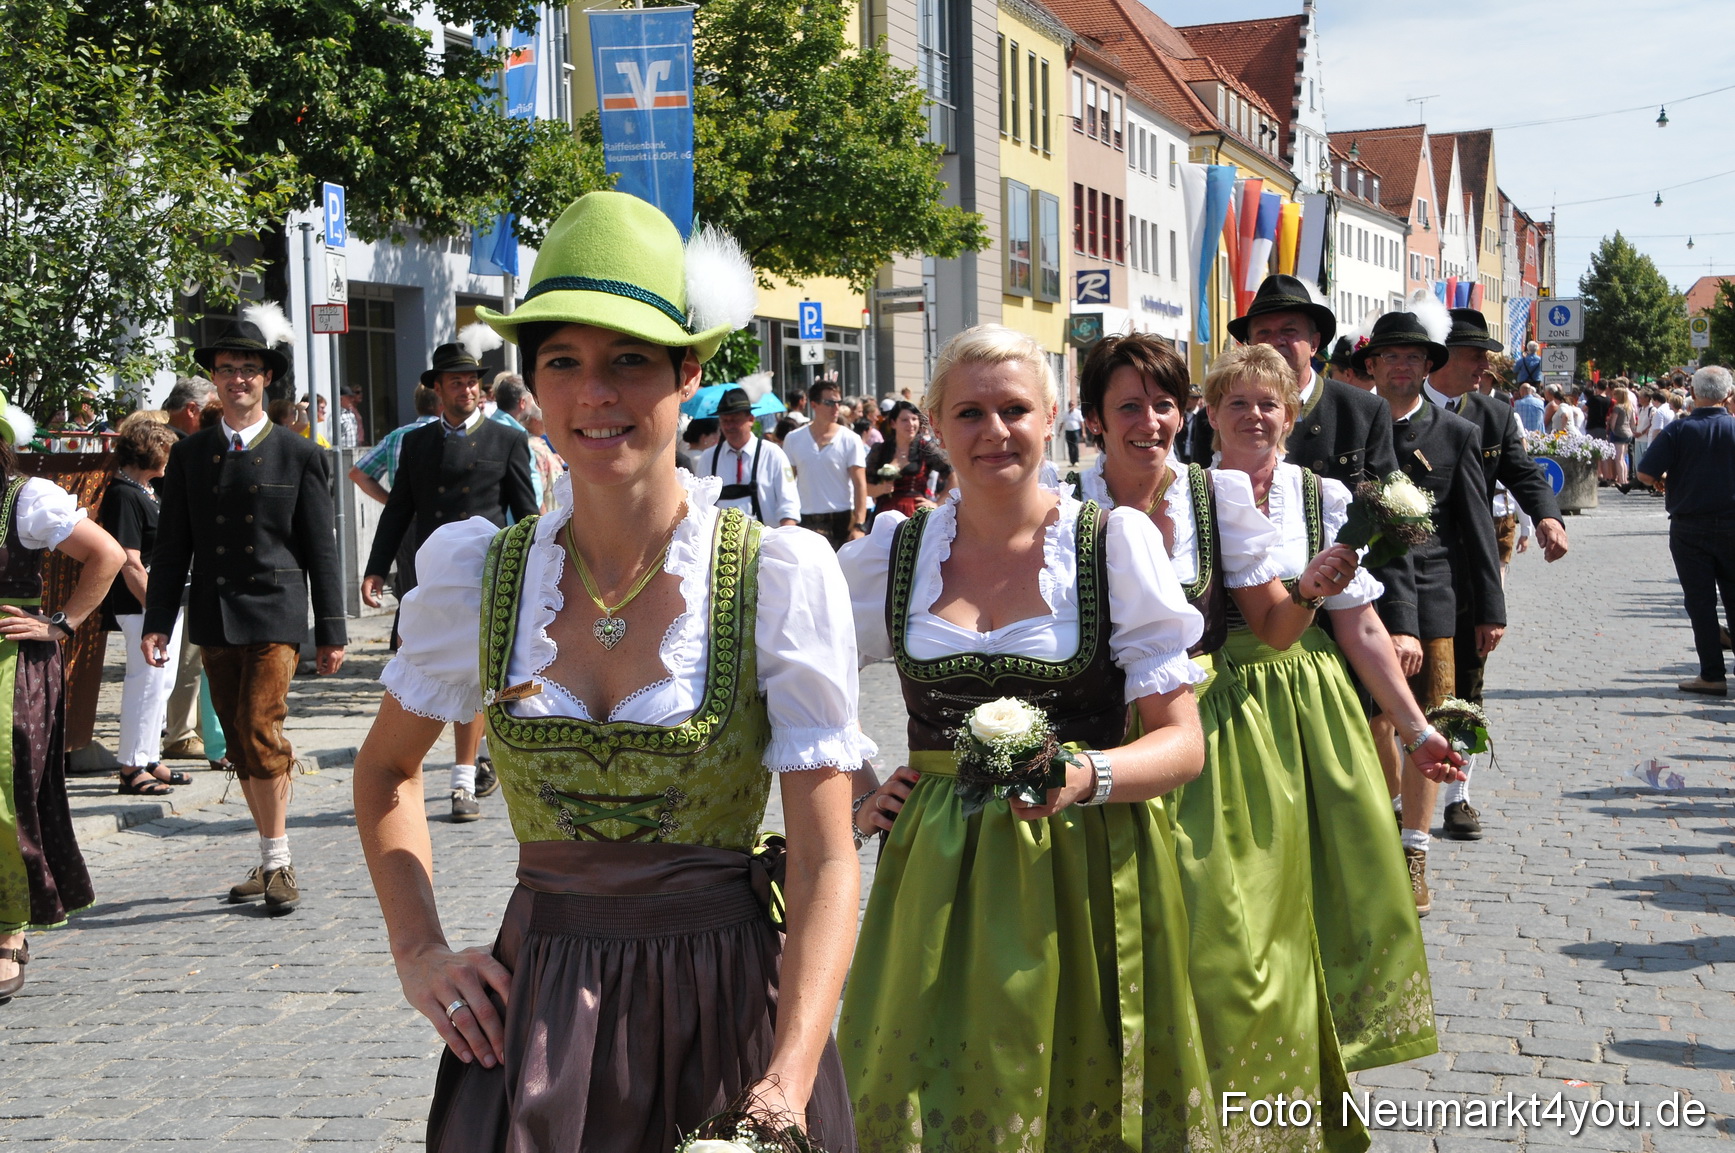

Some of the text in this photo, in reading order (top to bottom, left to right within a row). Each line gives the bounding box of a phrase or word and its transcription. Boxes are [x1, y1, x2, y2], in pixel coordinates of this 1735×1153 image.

[605, 141, 666, 152] Raiffeisenbank
[681, 151, 692, 160] eG
[329, 192, 340, 238] P
[804, 306, 818, 335] P
